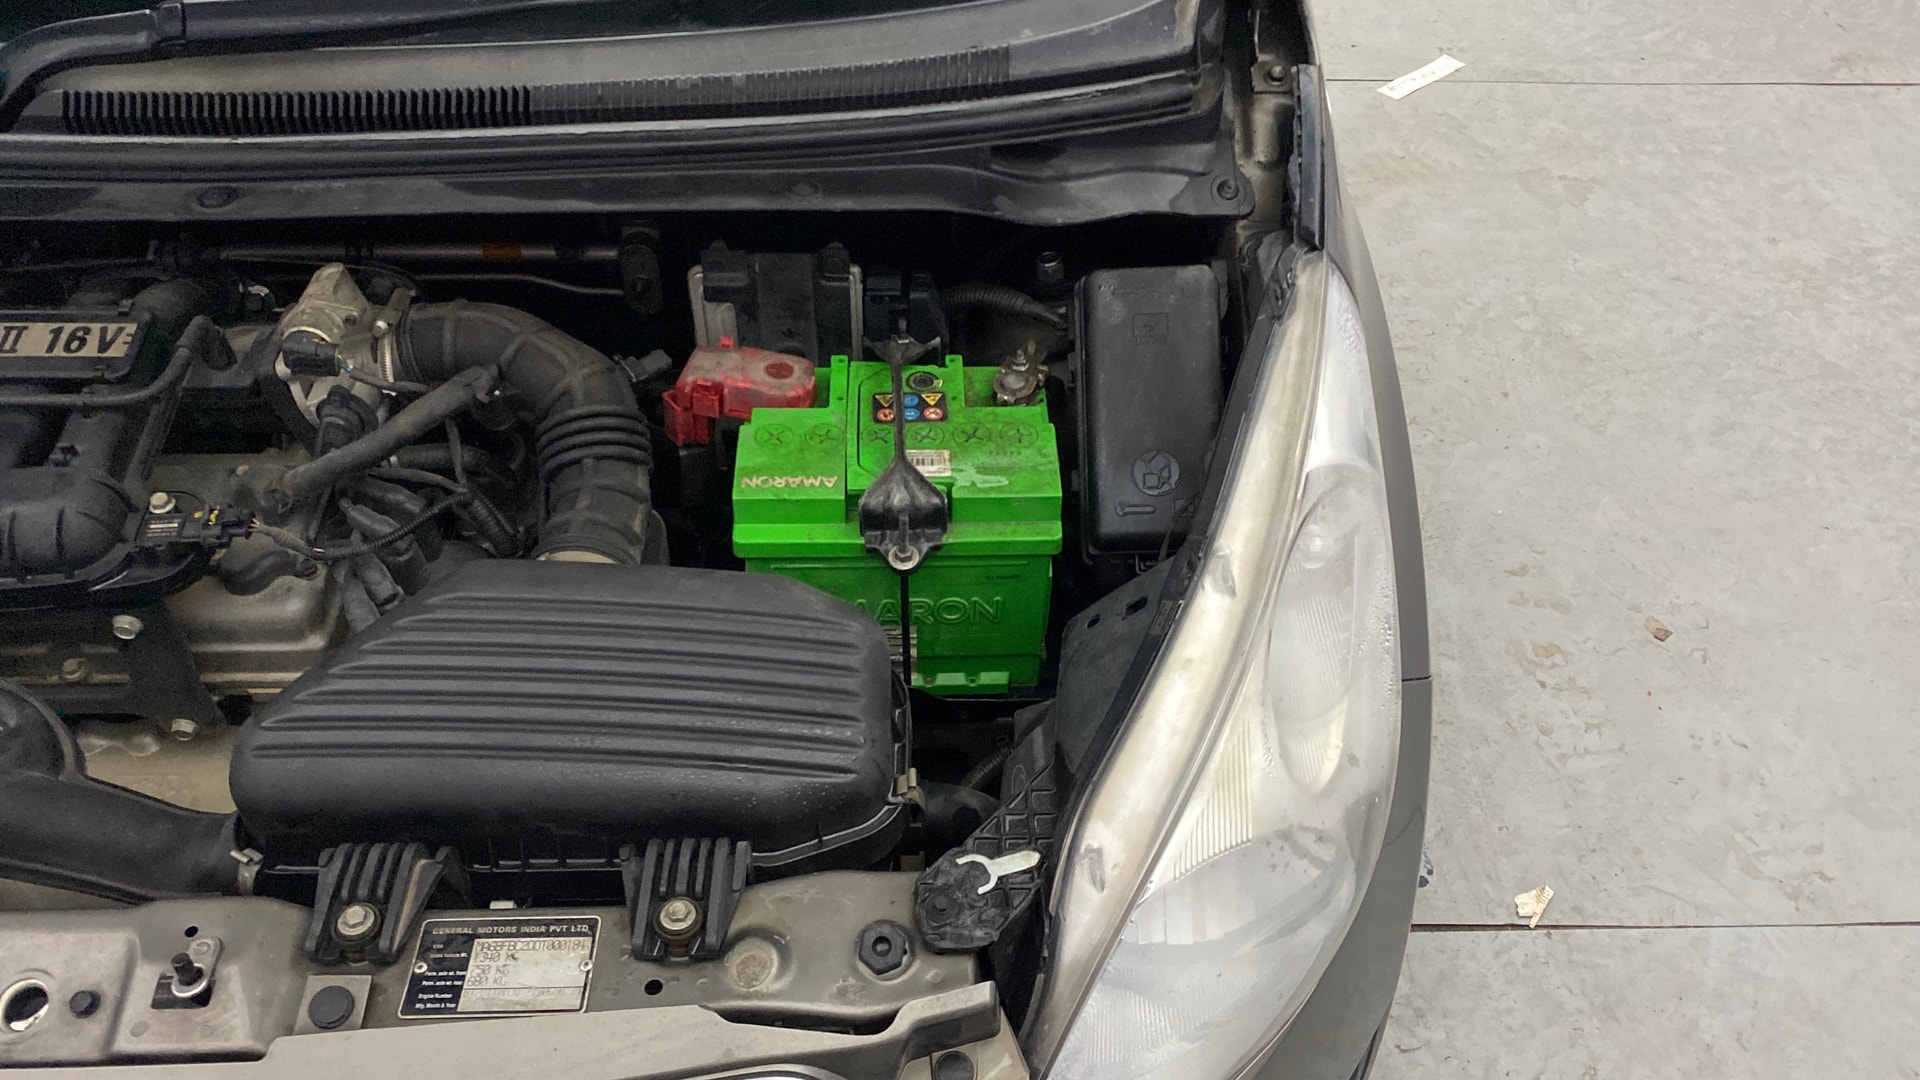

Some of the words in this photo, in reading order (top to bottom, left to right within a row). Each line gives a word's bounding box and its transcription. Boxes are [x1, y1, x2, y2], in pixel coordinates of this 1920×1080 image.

[741, 475, 838, 488] AMARON
[854, 596, 1003, 625] ARON
[432, 927, 473, 935] GENERAL
[477, 926, 517, 934] MOTORS
[520, 925, 546, 933] INDIA
[571, 924, 589, 932] LTD
[495, 964, 511, 976] KG
